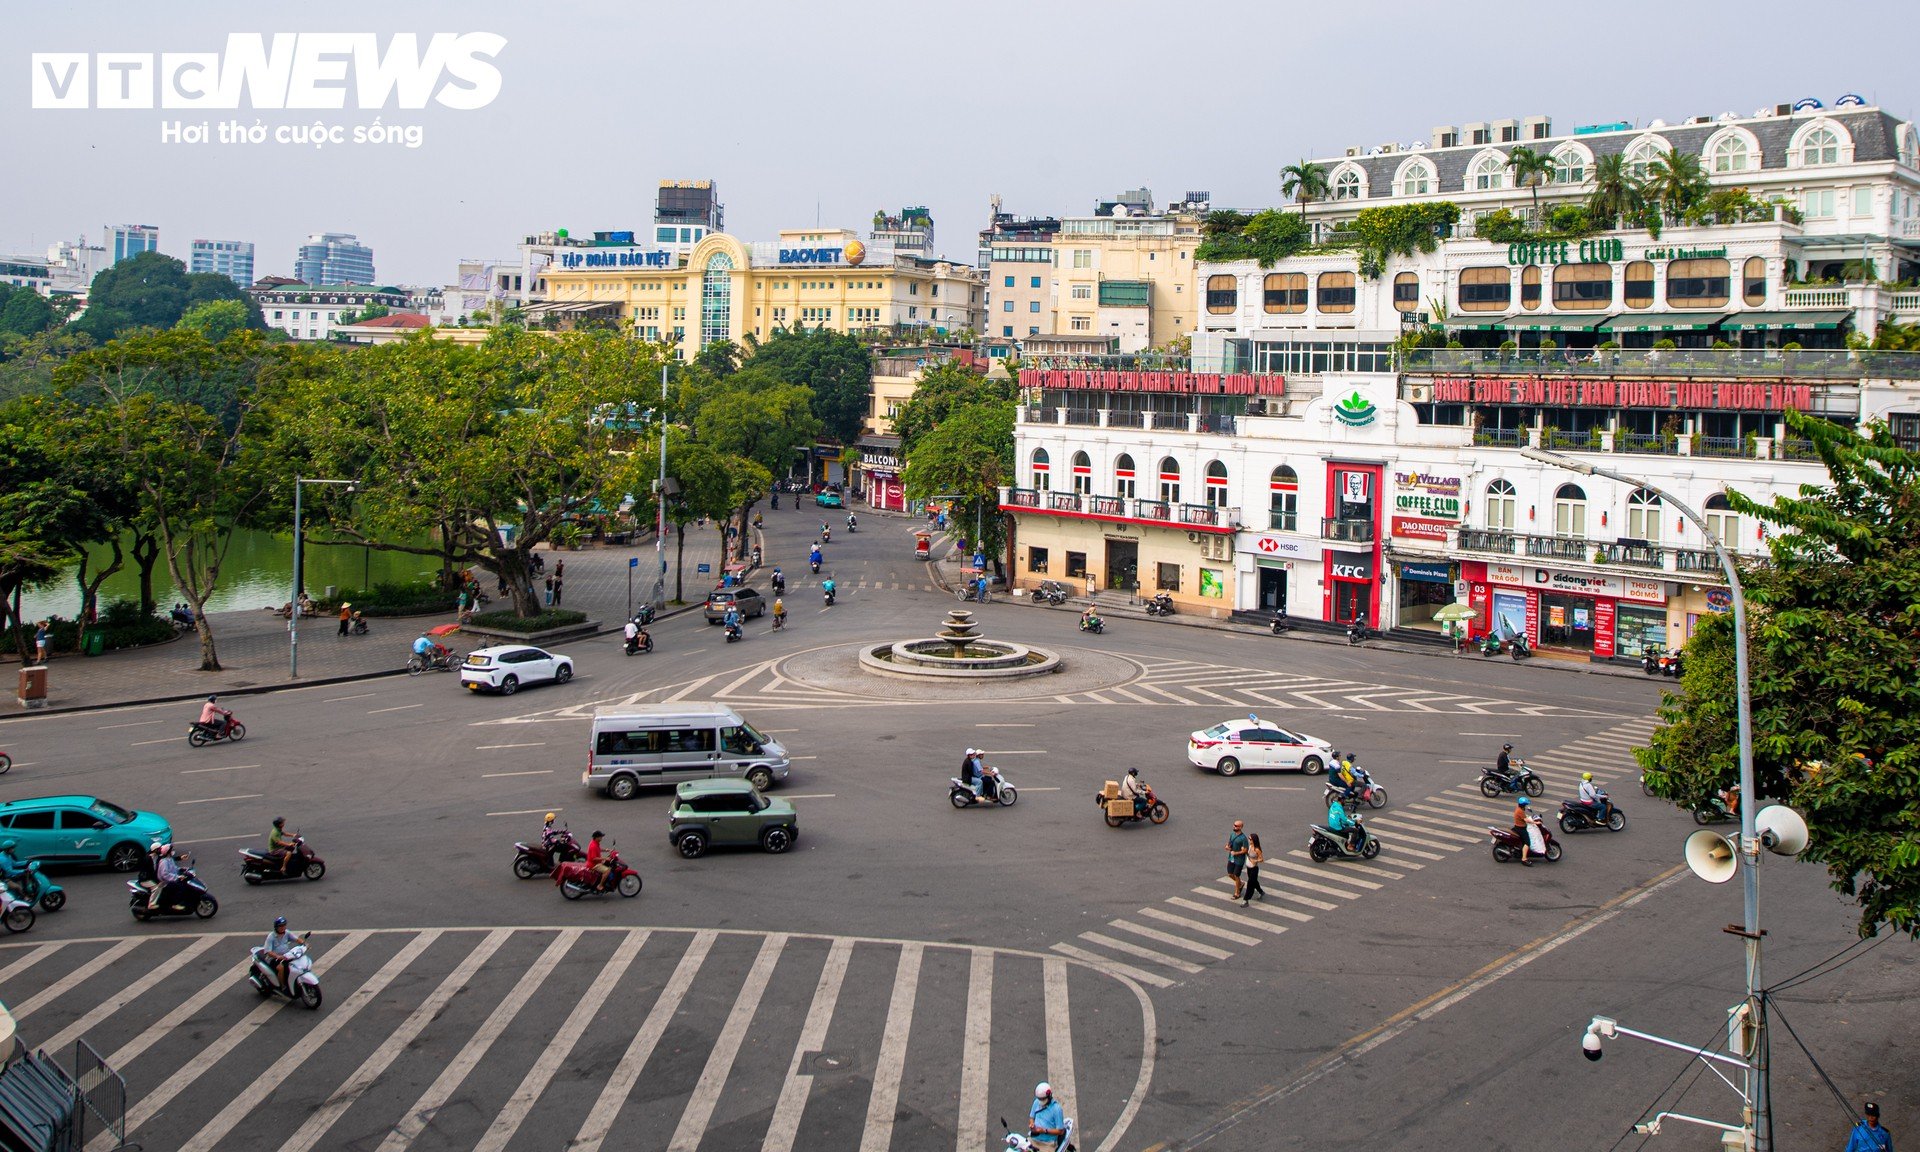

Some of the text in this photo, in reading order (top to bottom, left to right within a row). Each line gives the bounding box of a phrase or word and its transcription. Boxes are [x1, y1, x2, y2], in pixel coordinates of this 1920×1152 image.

[562, 248, 671, 269] TẬP ĐOÀN BẢO VIỆT
[1508, 239, 1622, 265] COFFEE CLUB
[1196, 374, 1219, 393] NAM
[1581, 381, 1616, 405] NAM
[1619, 382, 1670, 408] QUANG
[1676, 383, 1713, 408] VINH
[864, 454, 899, 466] BALCONY
[1397, 495, 1459, 511] COFFEE CLUB
[1402, 522, 1417, 530] DAO
[1419, 523, 1432, 531] NIU
[1280, 543, 1298, 551] HSBC
[1332, 564, 1364, 578] KFC
[1409, 568, 1432, 576] Domino's
[1474, 585, 1485, 593] 03
[1648, 582, 1658, 590] CŨ
